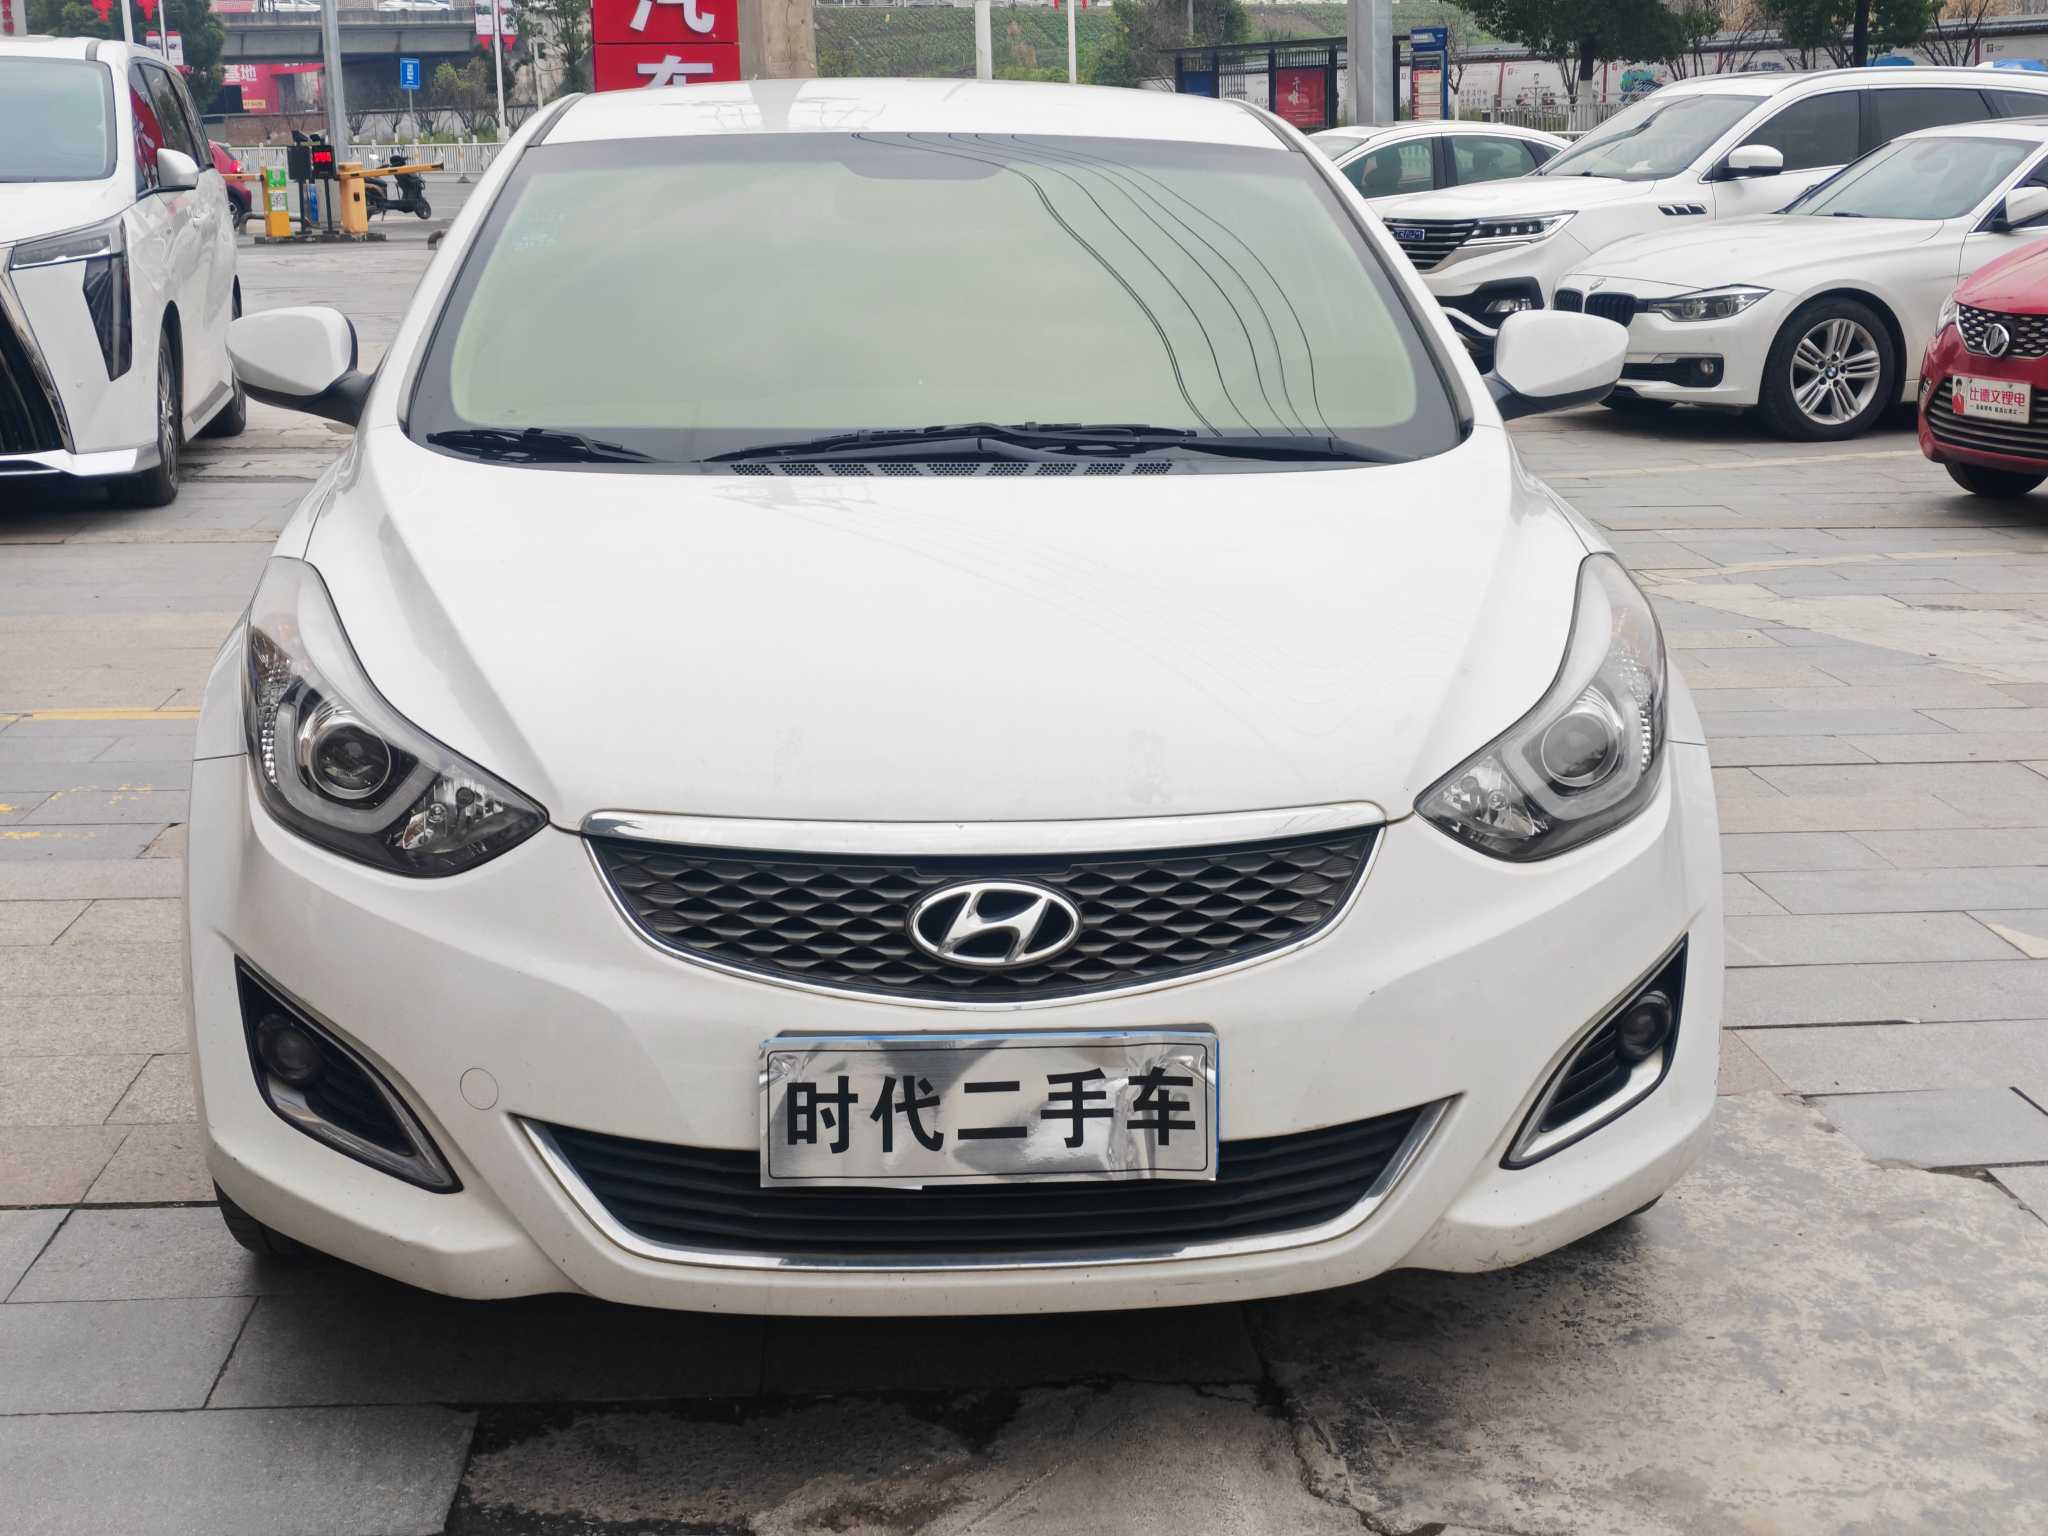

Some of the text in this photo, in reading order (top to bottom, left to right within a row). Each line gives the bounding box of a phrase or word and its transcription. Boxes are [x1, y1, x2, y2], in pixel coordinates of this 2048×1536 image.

[786, 1067, 1196, 1153] 时代二手车
